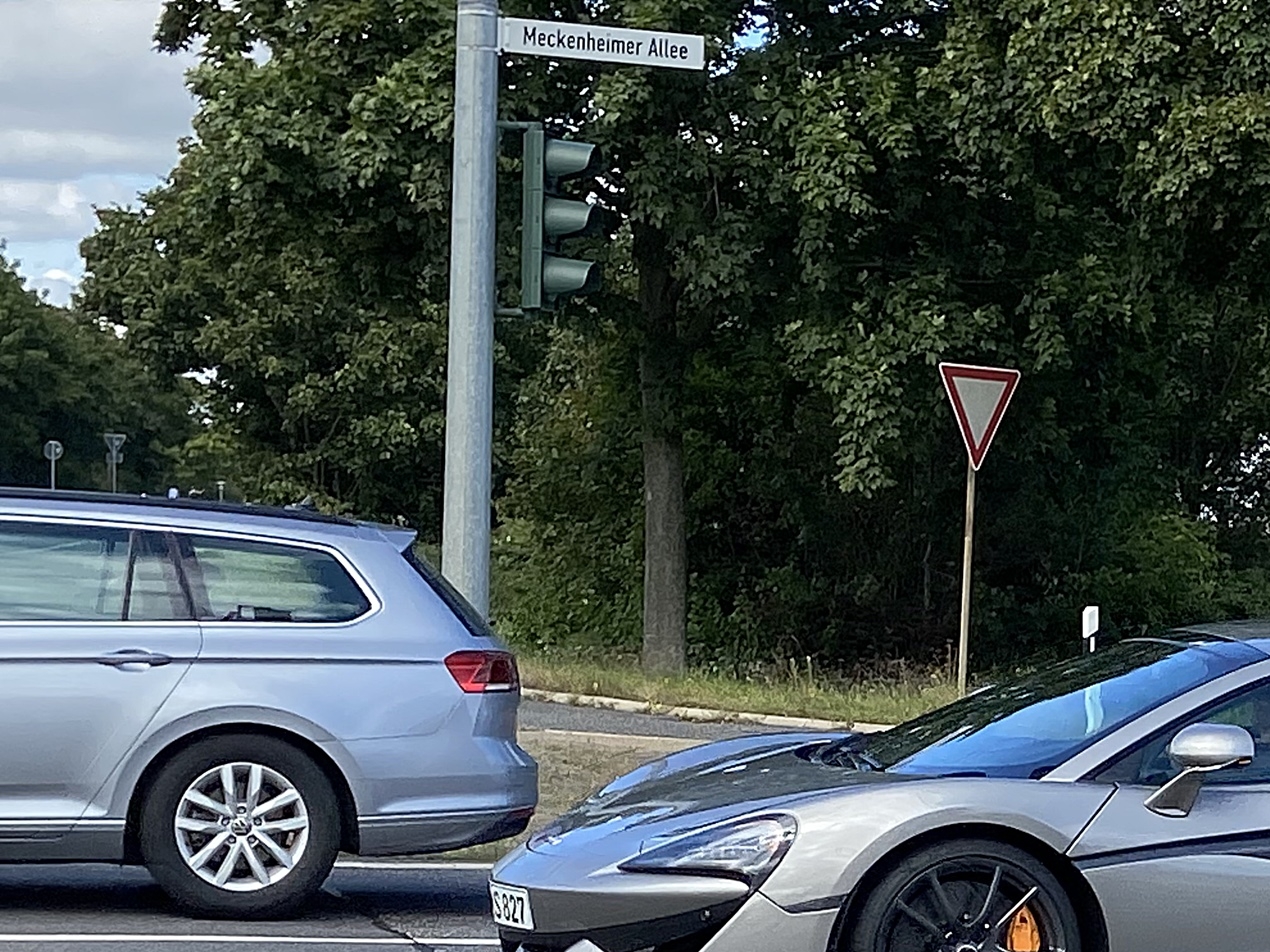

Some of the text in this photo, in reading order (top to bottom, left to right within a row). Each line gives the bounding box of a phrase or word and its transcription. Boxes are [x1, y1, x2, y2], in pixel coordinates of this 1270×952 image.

[523, 26, 689, 60] Meckenheimer Allee
[502, 893, 525, 925] 827
